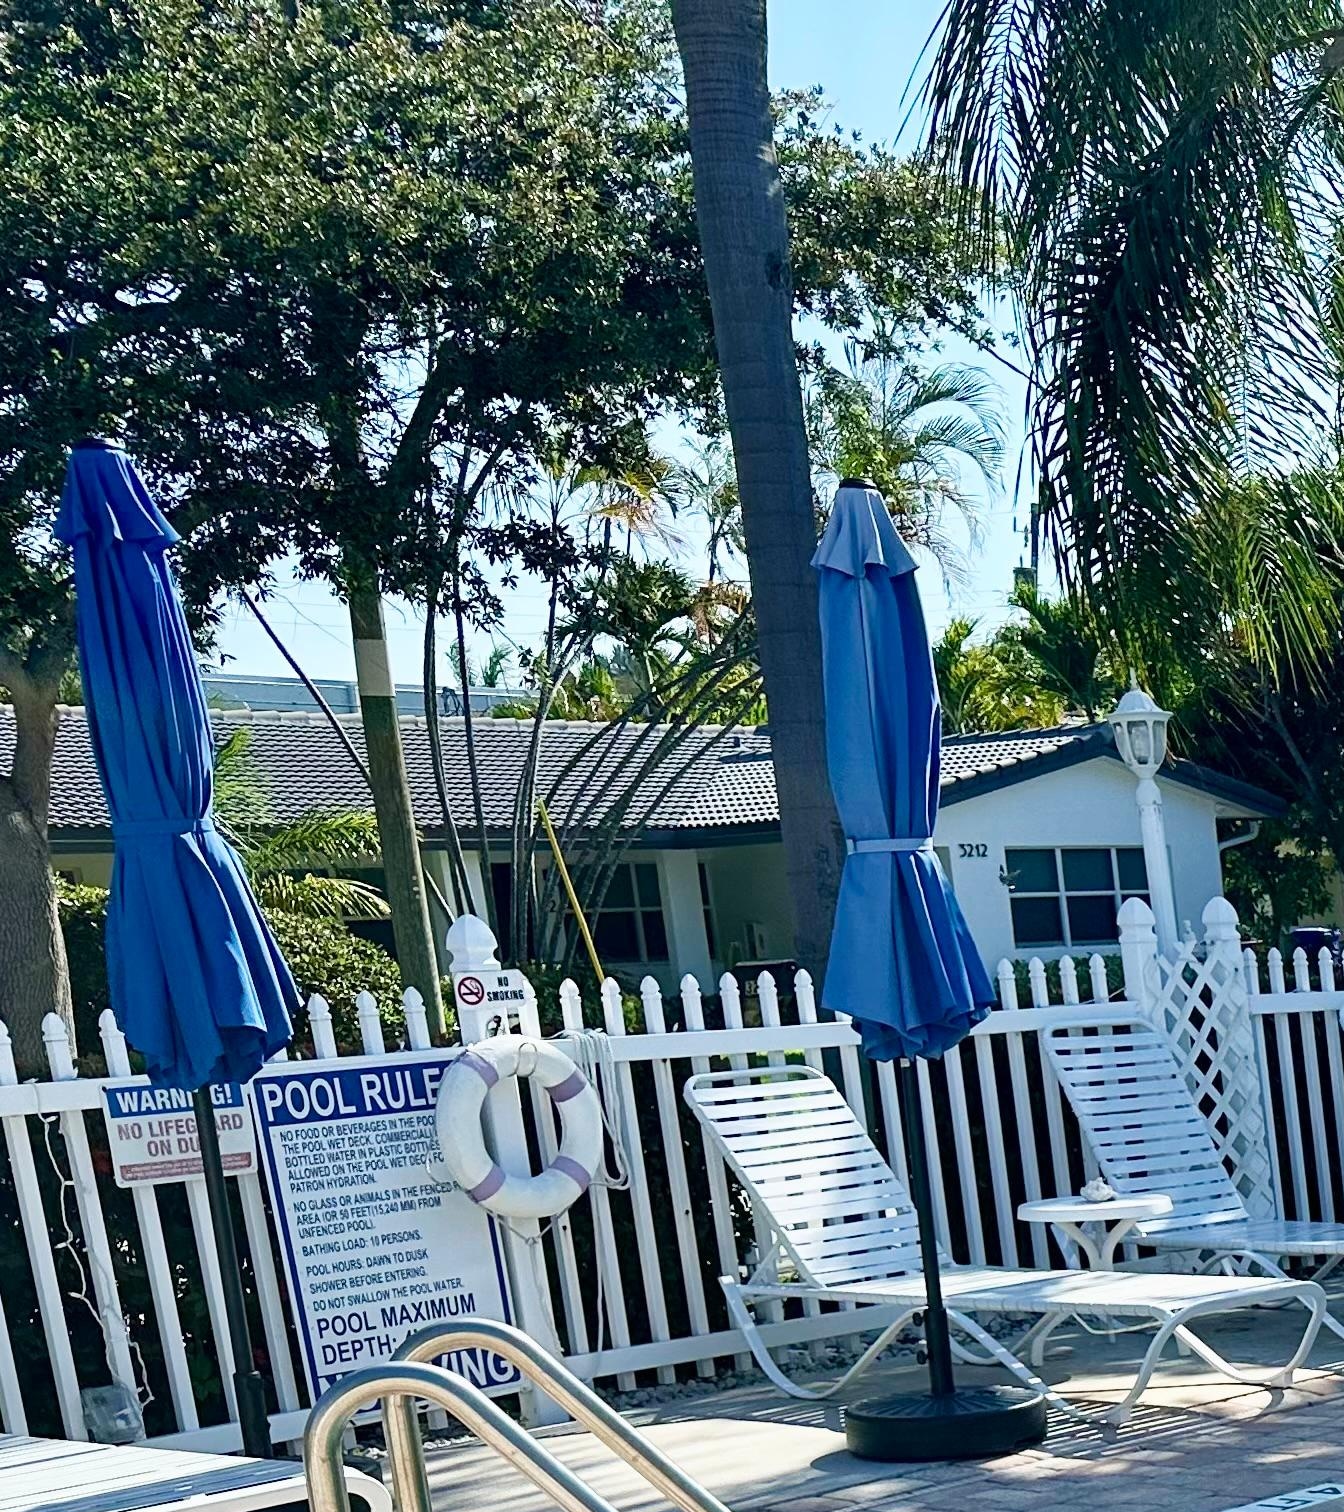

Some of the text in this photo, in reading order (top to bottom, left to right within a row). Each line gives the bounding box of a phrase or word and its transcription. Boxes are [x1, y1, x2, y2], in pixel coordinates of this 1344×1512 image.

[958, 843, 988, 858] 3212
[497, 976, 509, 987] NO
[486, 990, 525, 1002] SMOKING
[116, 1083, 233, 1113] WARNIG!
[262, 1066, 450, 1122] POOL RULE
[117, 1113, 244, 1141] NO LIFEGRD
[280, 1115, 435, 1142] NO FOOD OR BEVERAGES IN THE POO
[147, 1139, 172, 1157] ON
[282, 1143, 299, 1155] THE
[301, 1140, 326, 1153] POOL
[327, 1139, 346, 1150] WET
[285, 1140, 441, 1169] BOTTLED WATER IN PLASTIC BOTTES
[288, 1166, 331, 1181] ALLOWED
[332, 1164, 346, 1176] ON
[348, 1162, 364, 1173] THE
[366, 1158, 389, 1172] POOL
[390, 1156, 408, 1168] WET
[409, 1154, 432, 1166] DEC
[290, 1179, 326, 1193] PATRON
[293, 1201, 307, 1212] NO
[309, 1197, 337, 1211] GLASS
[339, 1195, 352, 1206] OR
[354, 1189, 390, 1204] ANIMALS
[392, 1189, 401, 1199] IN
[402, 1186, 417, 1198] THE
[419, 1181, 452, 1196] FENCED
[296, 1214, 320, 1226] AREA
[322, 1211, 338, 1222] (OR
[339, 1210, 349, 1220] 50
[400, 1201, 417, 1211] MM)
[418, 1197, 441, 1209] FROM
[298, 1224, 346, 1239] UNFENCED
[302, 1242, 341, 1257] BATHING
[343, 1239, 369, 1251] LOAD:
[371, 1236, 380, 1247] 10
[306, 1265, 329, 1277] POOL
[366, 1256, 392, 1268] DAWN
[393, 1252, 404, 1263] TO
[406, 1249, 429, 1261] DUSK
[310, 1279, 348, 1294] SHOWER
[350, 1273, 383, 1287] BEFORE
[313, 1300, 327, 1311] DO
[328, 1298, 345, 1309] NOT
[347, 1290, 390, 1306] SWALLOW
[392, 1287, 408, 1298] THE
[410, 1284, 432, 1296] POOL
[316, 1311, 376, 1339] POOL
[381, 1293, 476, 1328] MAXIMUM
[1307, 1487, 1342, 1495] 4
[1257, 1498, 1315, 1511] FT
